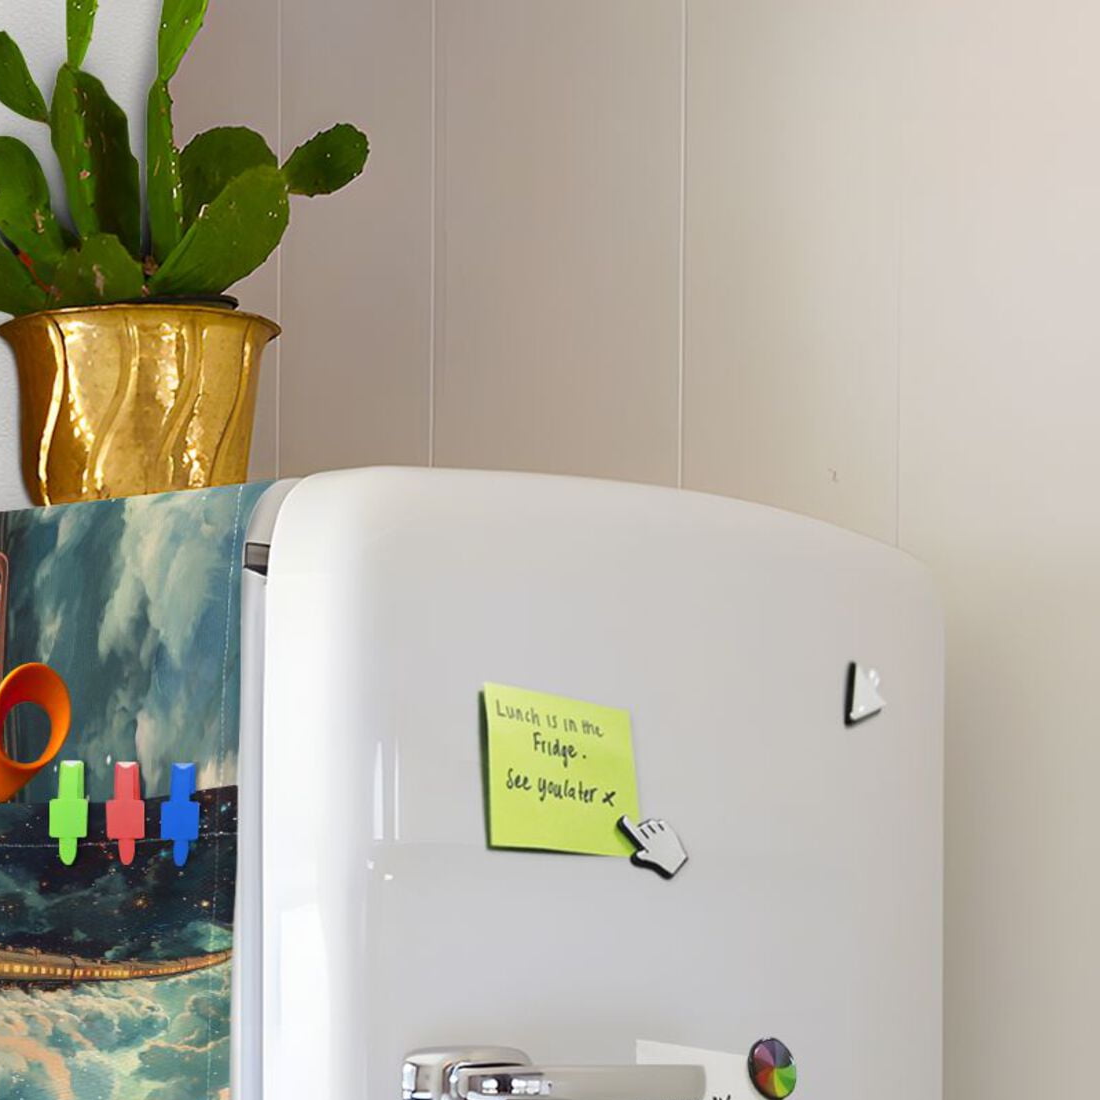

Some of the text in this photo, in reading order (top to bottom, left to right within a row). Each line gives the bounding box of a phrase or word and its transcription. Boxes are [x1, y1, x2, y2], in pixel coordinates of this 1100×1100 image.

[495, 698, 541, 727] Lunch
[563, 717, 579, 733] in
[581, 718, 604, 738] the
[505, 767, 532, 791] See
